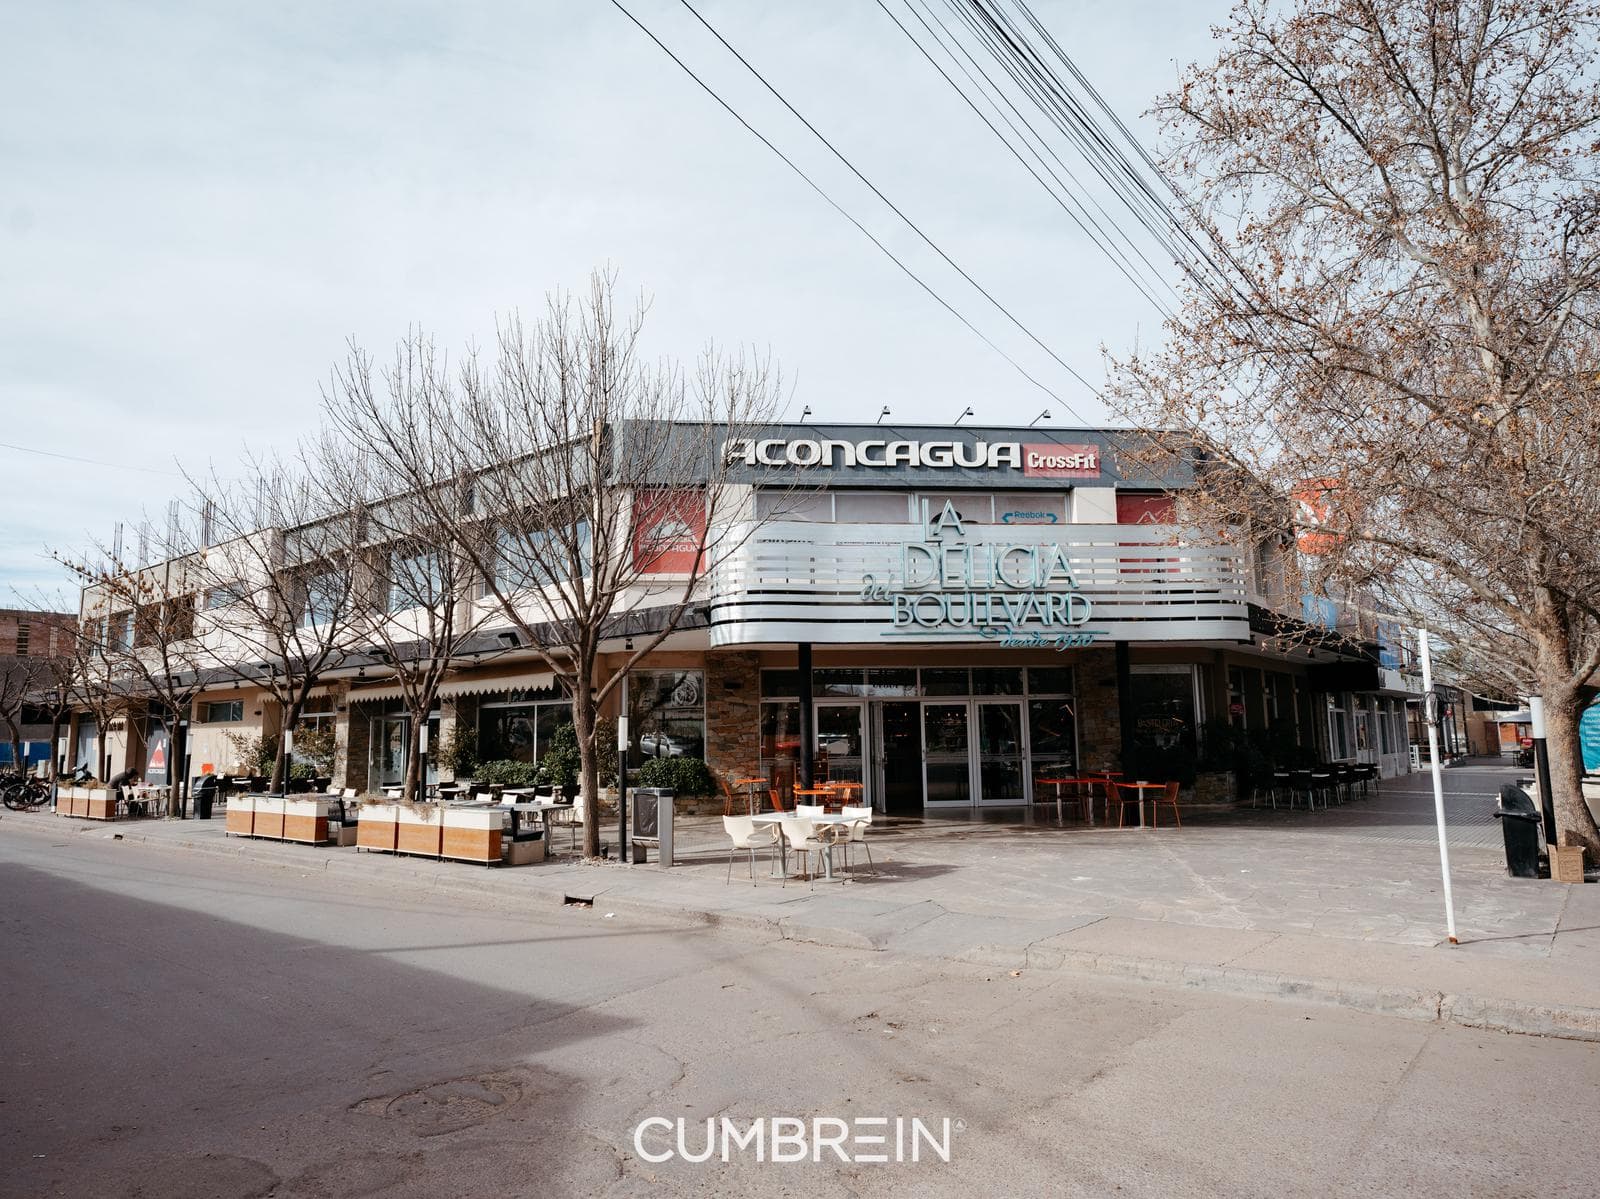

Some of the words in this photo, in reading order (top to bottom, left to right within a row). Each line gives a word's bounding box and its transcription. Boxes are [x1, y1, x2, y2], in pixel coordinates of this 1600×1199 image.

[720, 437, 1021, 469] ACONCAGUA
[1022, 451, 1097, 470] CrossFit
[921, 497, 965, 543] LA
[1014, 510, 1046, 520] Reebok
[902, 541, 1080, 590] DELICIA
[860, 573, 895, 602] del
[892, 591, 1092, 628] BOULEVARD
[993, 629, 1050, 648] desde
